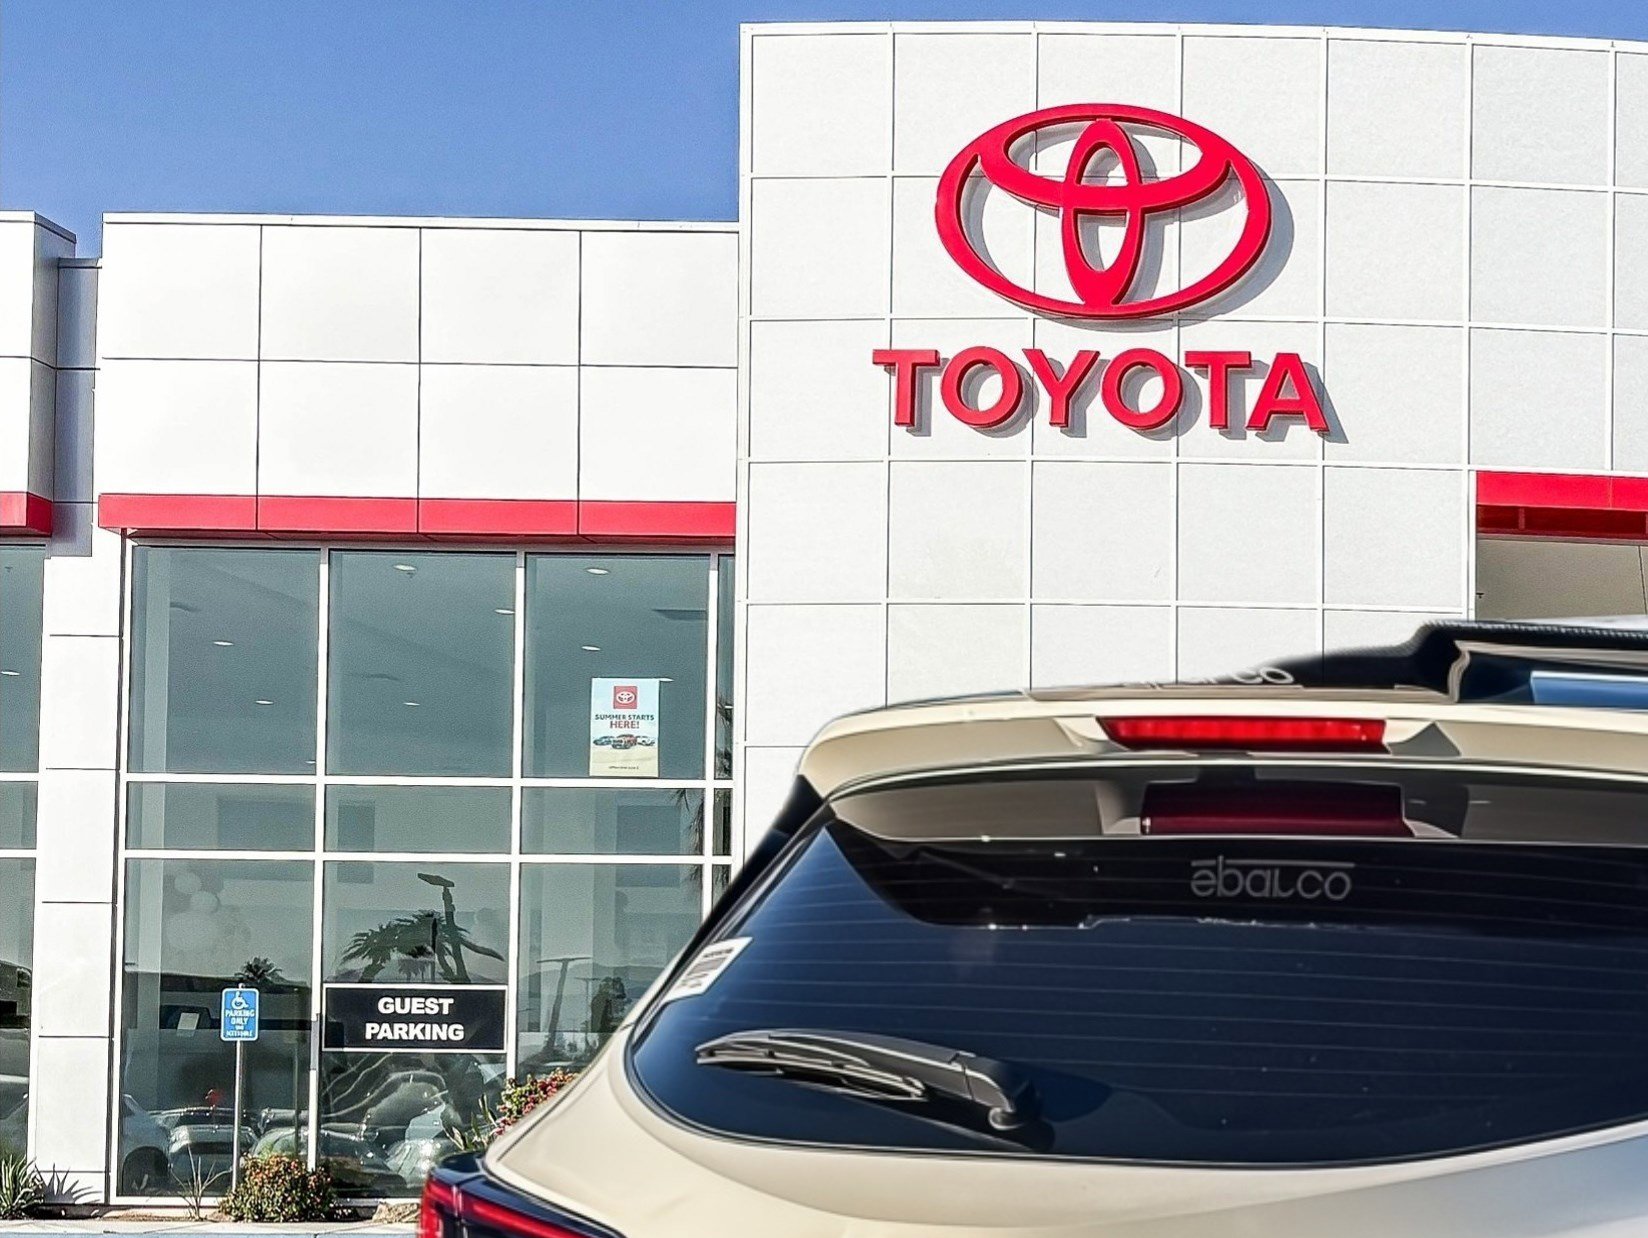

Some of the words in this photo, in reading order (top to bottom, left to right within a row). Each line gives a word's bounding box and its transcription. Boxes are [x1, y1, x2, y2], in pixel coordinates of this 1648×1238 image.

[873, 346, 1330, 432] TOYOTA
[609, 720, 640, 729] HERE!
[377, 997, 454, 1015] GUEST
[365, 1022, 465, 1041] PARKING
